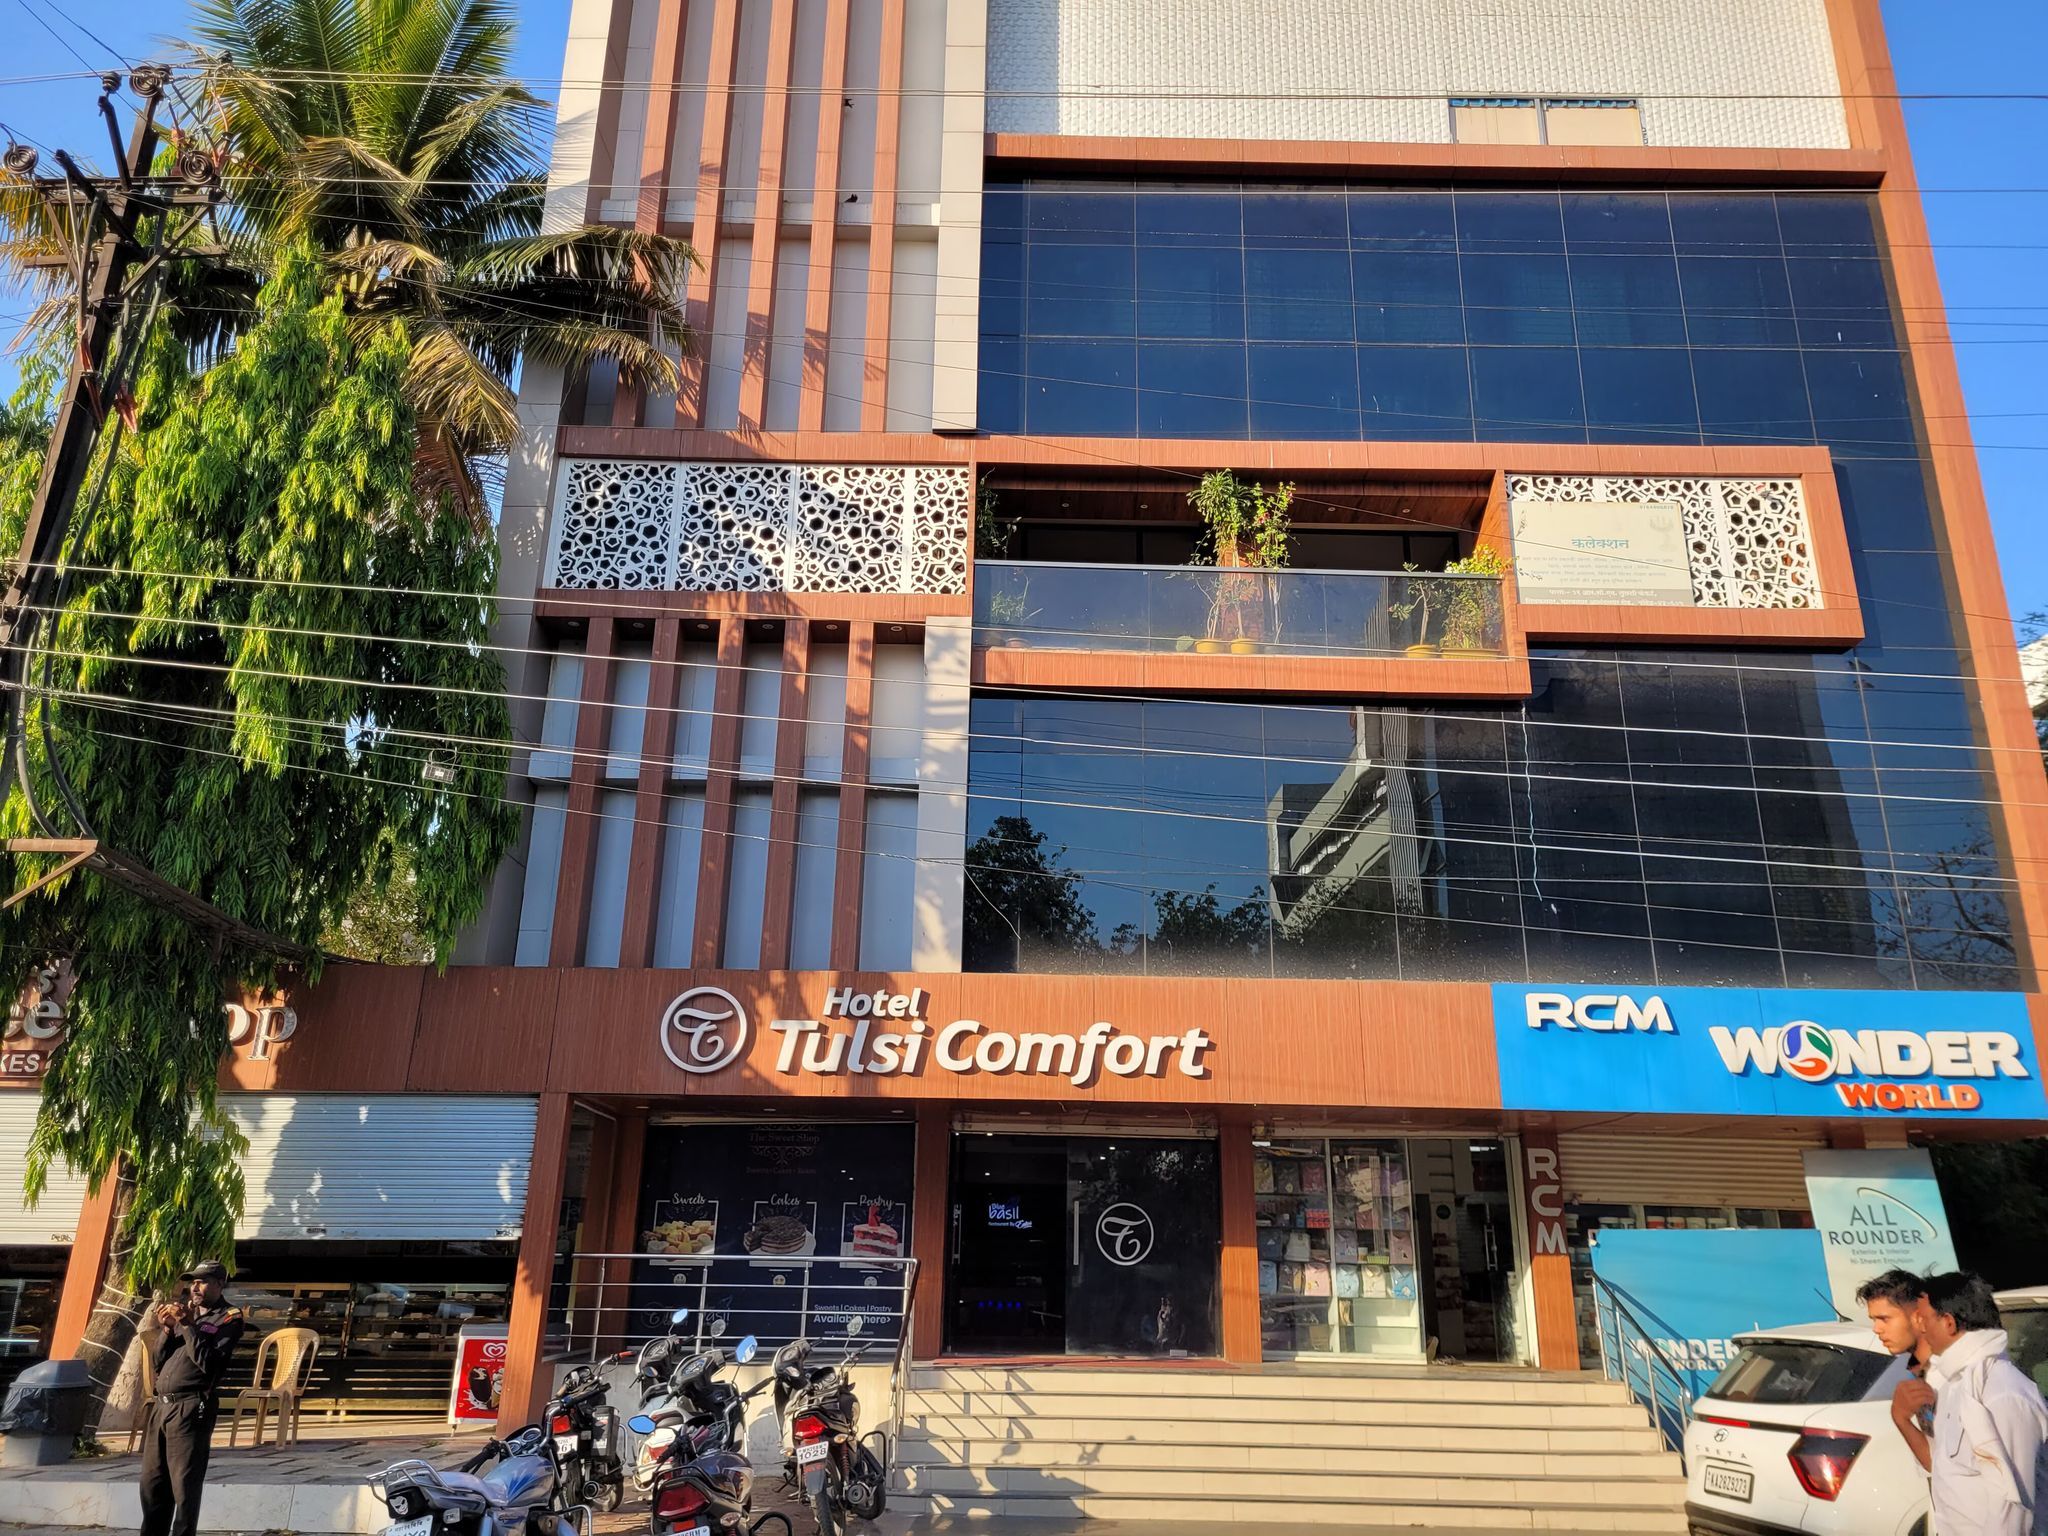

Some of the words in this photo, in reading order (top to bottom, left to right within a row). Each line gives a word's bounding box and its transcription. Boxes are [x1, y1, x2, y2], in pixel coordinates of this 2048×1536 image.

[823, 987, 922, 1018] Hotel
[1525, 993, 1675, 1032] RCM
[769, 1019, 926, 1074] Tulsi
[934, 1019, 1209, 1085] Comfort
[1709, 1020, 2029, 1082] WONDER
[1836, 1083, 1981, 1110] WORLD
[672, 1192, 706, 1205] Sweets
[770, 1193, 800, 1206] Cakes
[859, 1194, 895, 1211] Pastry
[1527, 1147, 1568, 1255] RCM
[988, 1204, 1019, 1220] basil
[1850, 1204, 1898, 1226] ALL
[1828, 1229, 1925, 1245] ROUNDER
[813, 1314, 854, 1325] Availab
[799, 1447, 827, 1461] 1028
